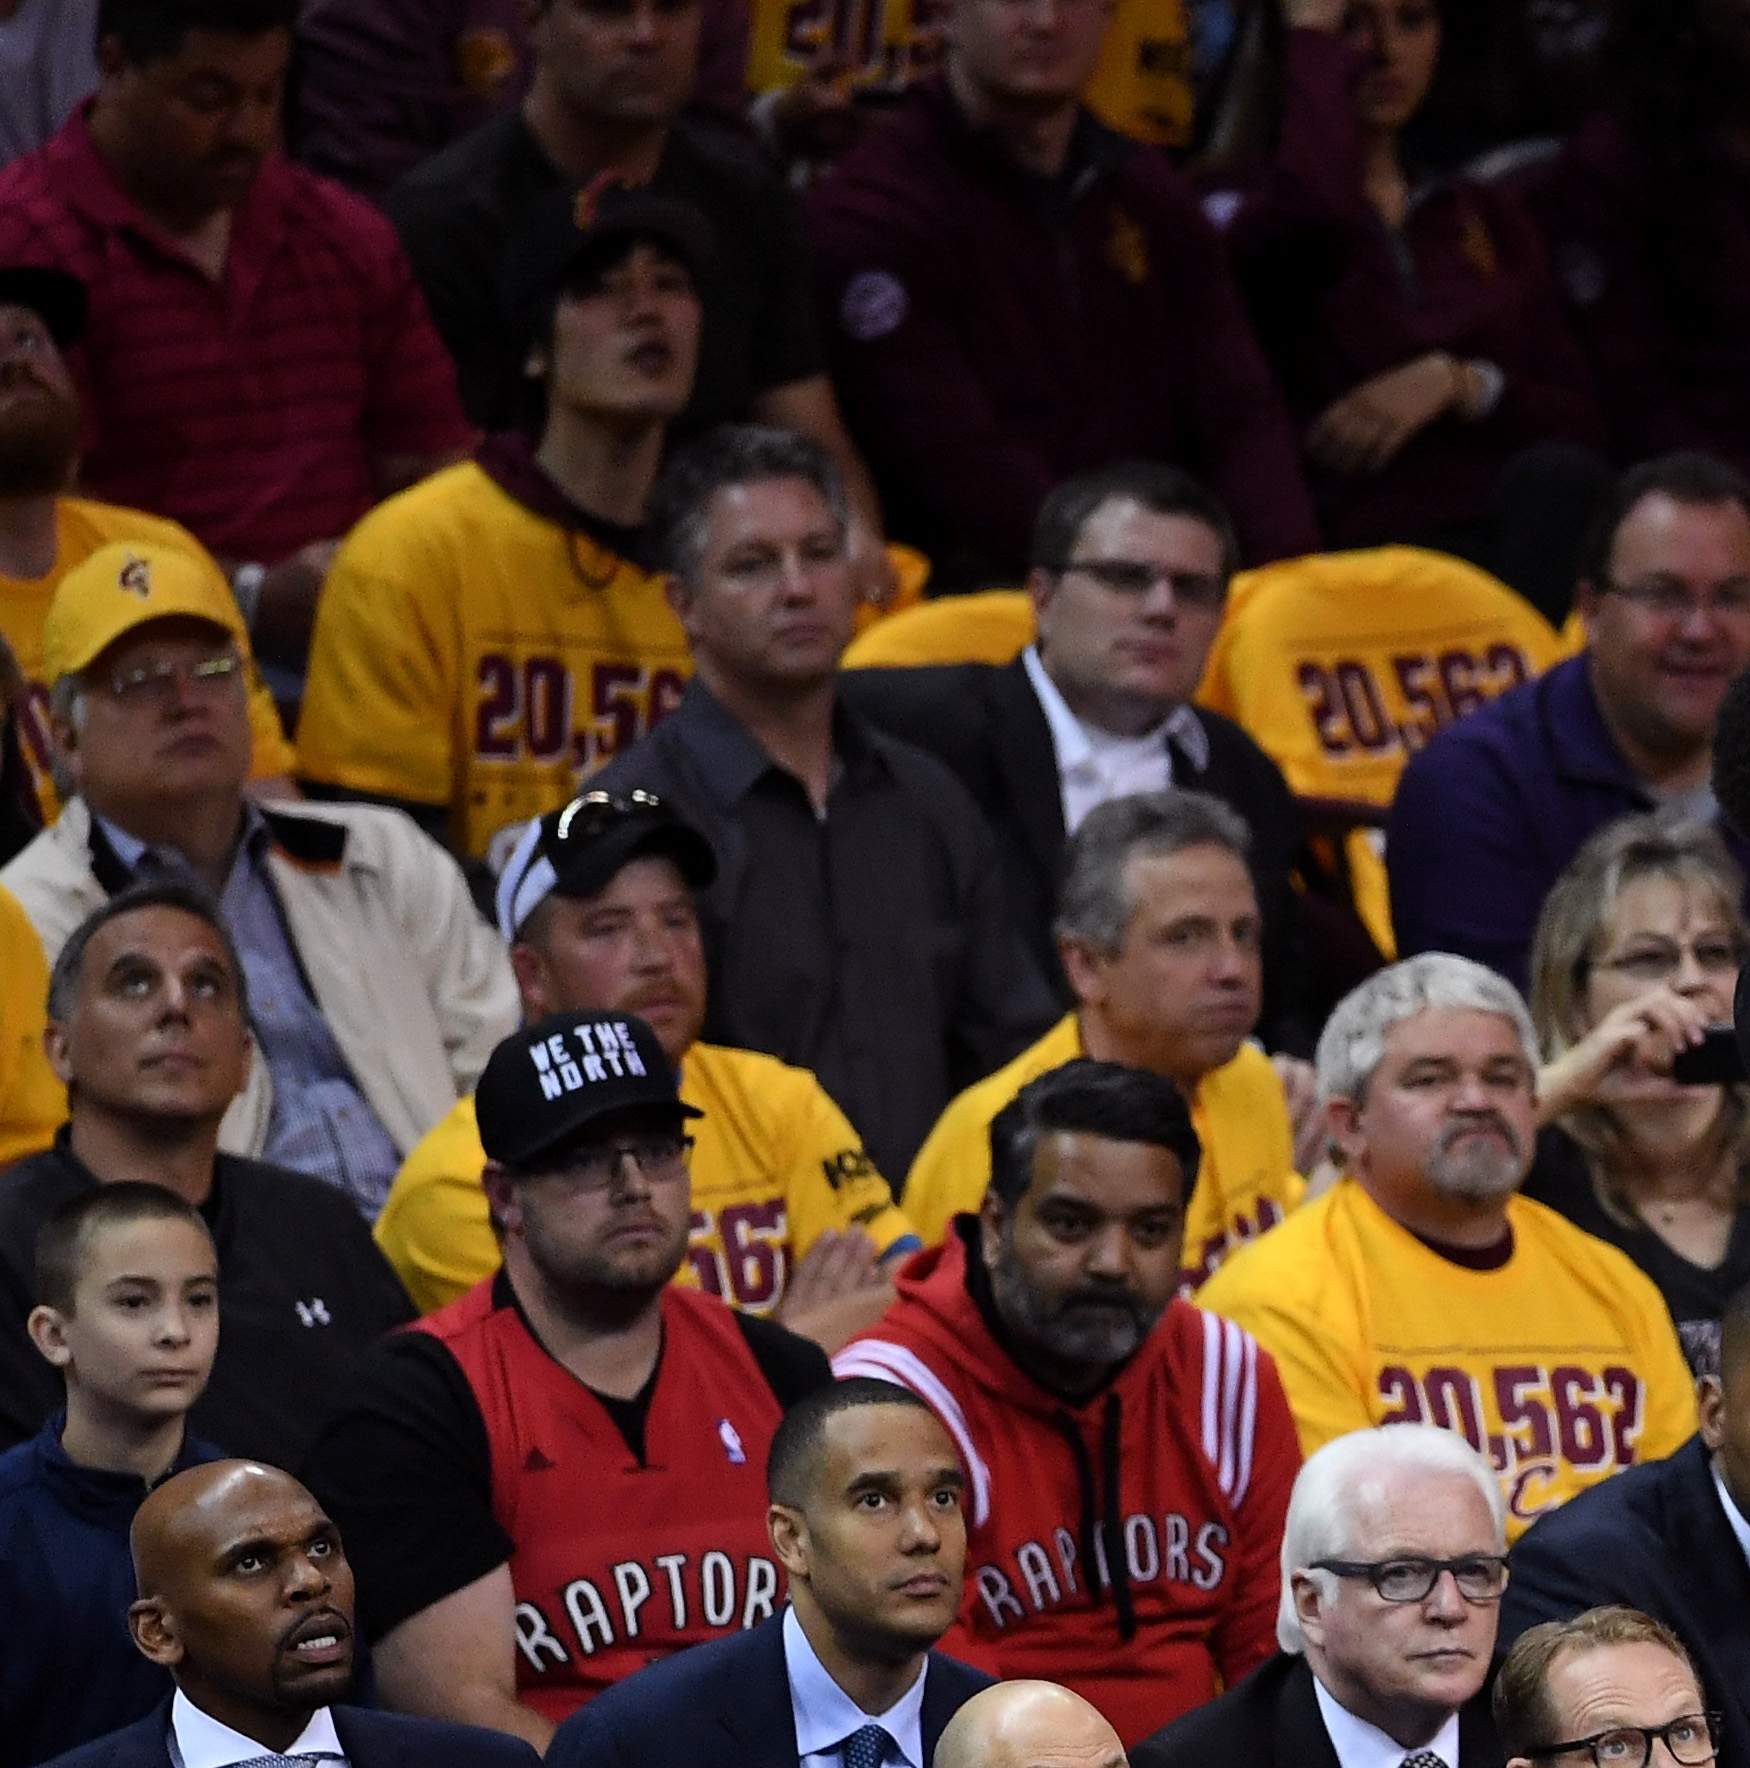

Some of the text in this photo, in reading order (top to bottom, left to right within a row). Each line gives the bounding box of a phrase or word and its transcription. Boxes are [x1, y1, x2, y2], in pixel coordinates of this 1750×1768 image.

[475, 650, 690, 772] 20,56
[529, 1020, 636, 1074] WE THE
[539, 1048, 648, 1101] NORTH
[515, 1551, 784, 1673] RAPTOR
